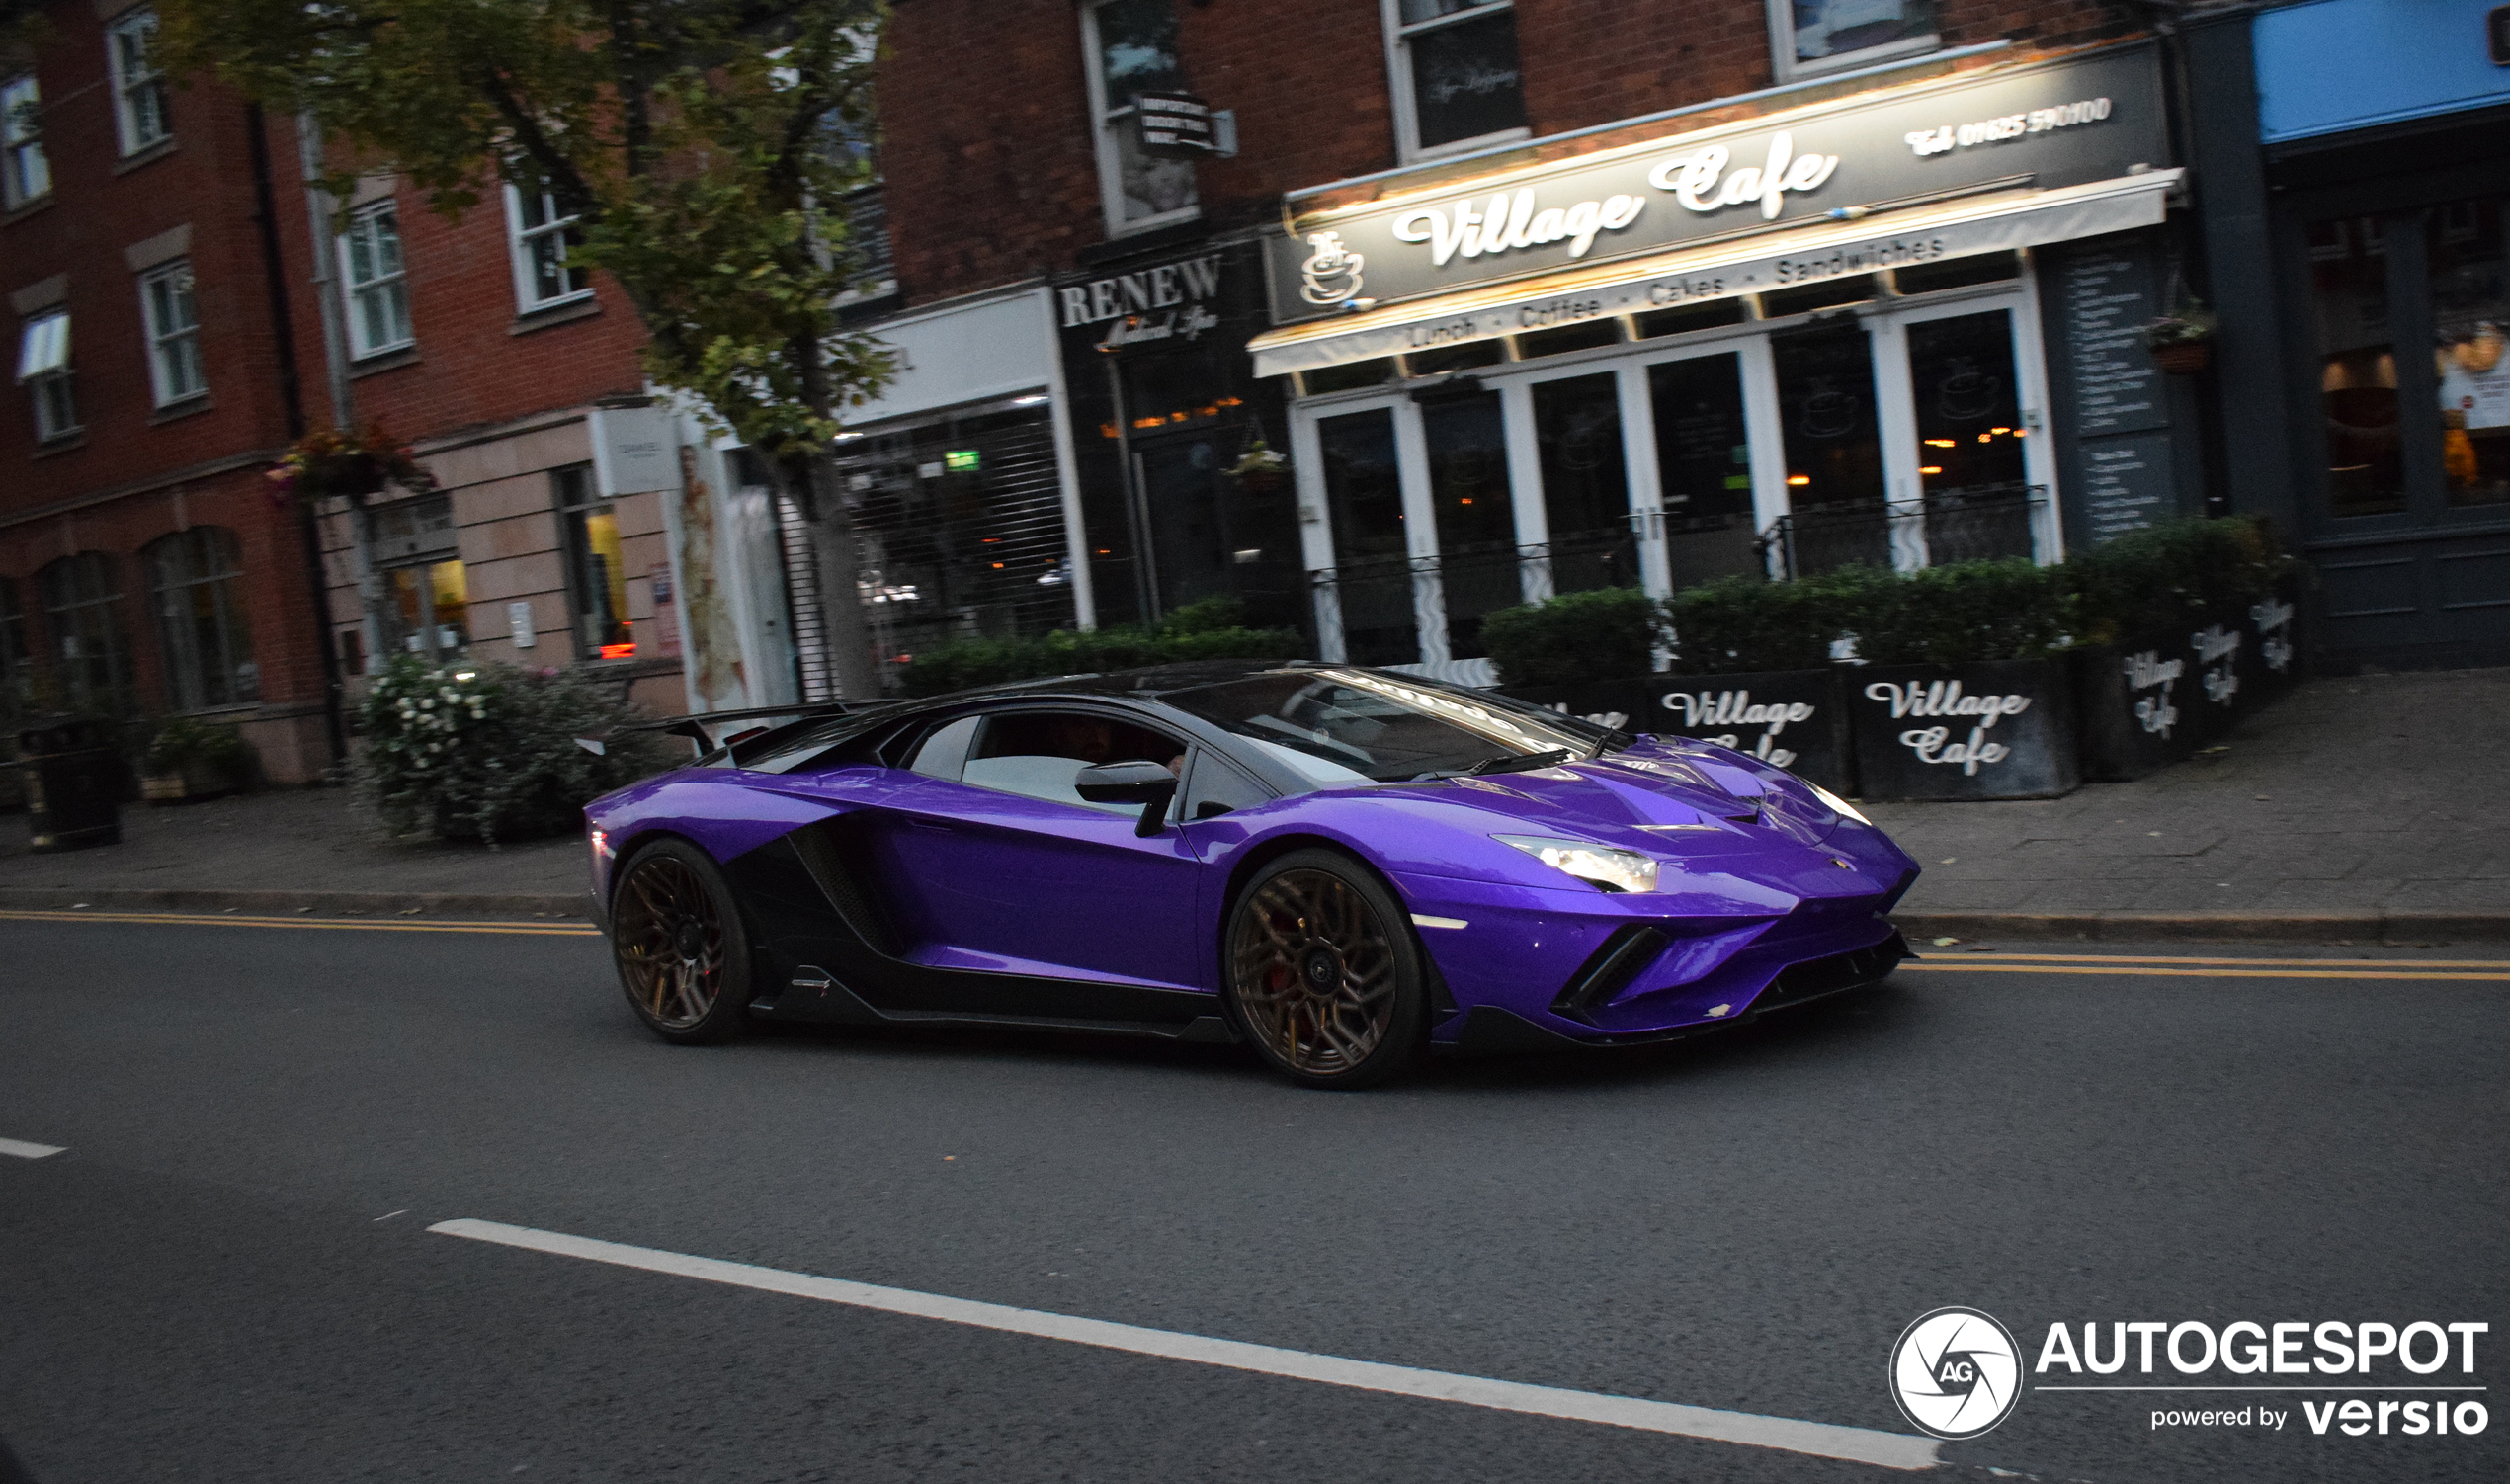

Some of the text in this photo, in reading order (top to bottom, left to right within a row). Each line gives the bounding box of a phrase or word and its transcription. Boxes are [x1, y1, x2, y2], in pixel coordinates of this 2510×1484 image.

[1957, 114, 2026, 147] 01625
[1392, 130, 1839, 265] Village Cafe
[1058, 254, 1223, 327] RENEW
[1406, 238, 1945, 348] Lunch Coffee Cakes Sandwiches
[1661, 690, 1816, 735] Village
[1865, 680, 2033, 729] Village
[1898, 725, 2011, 777] Cafe
